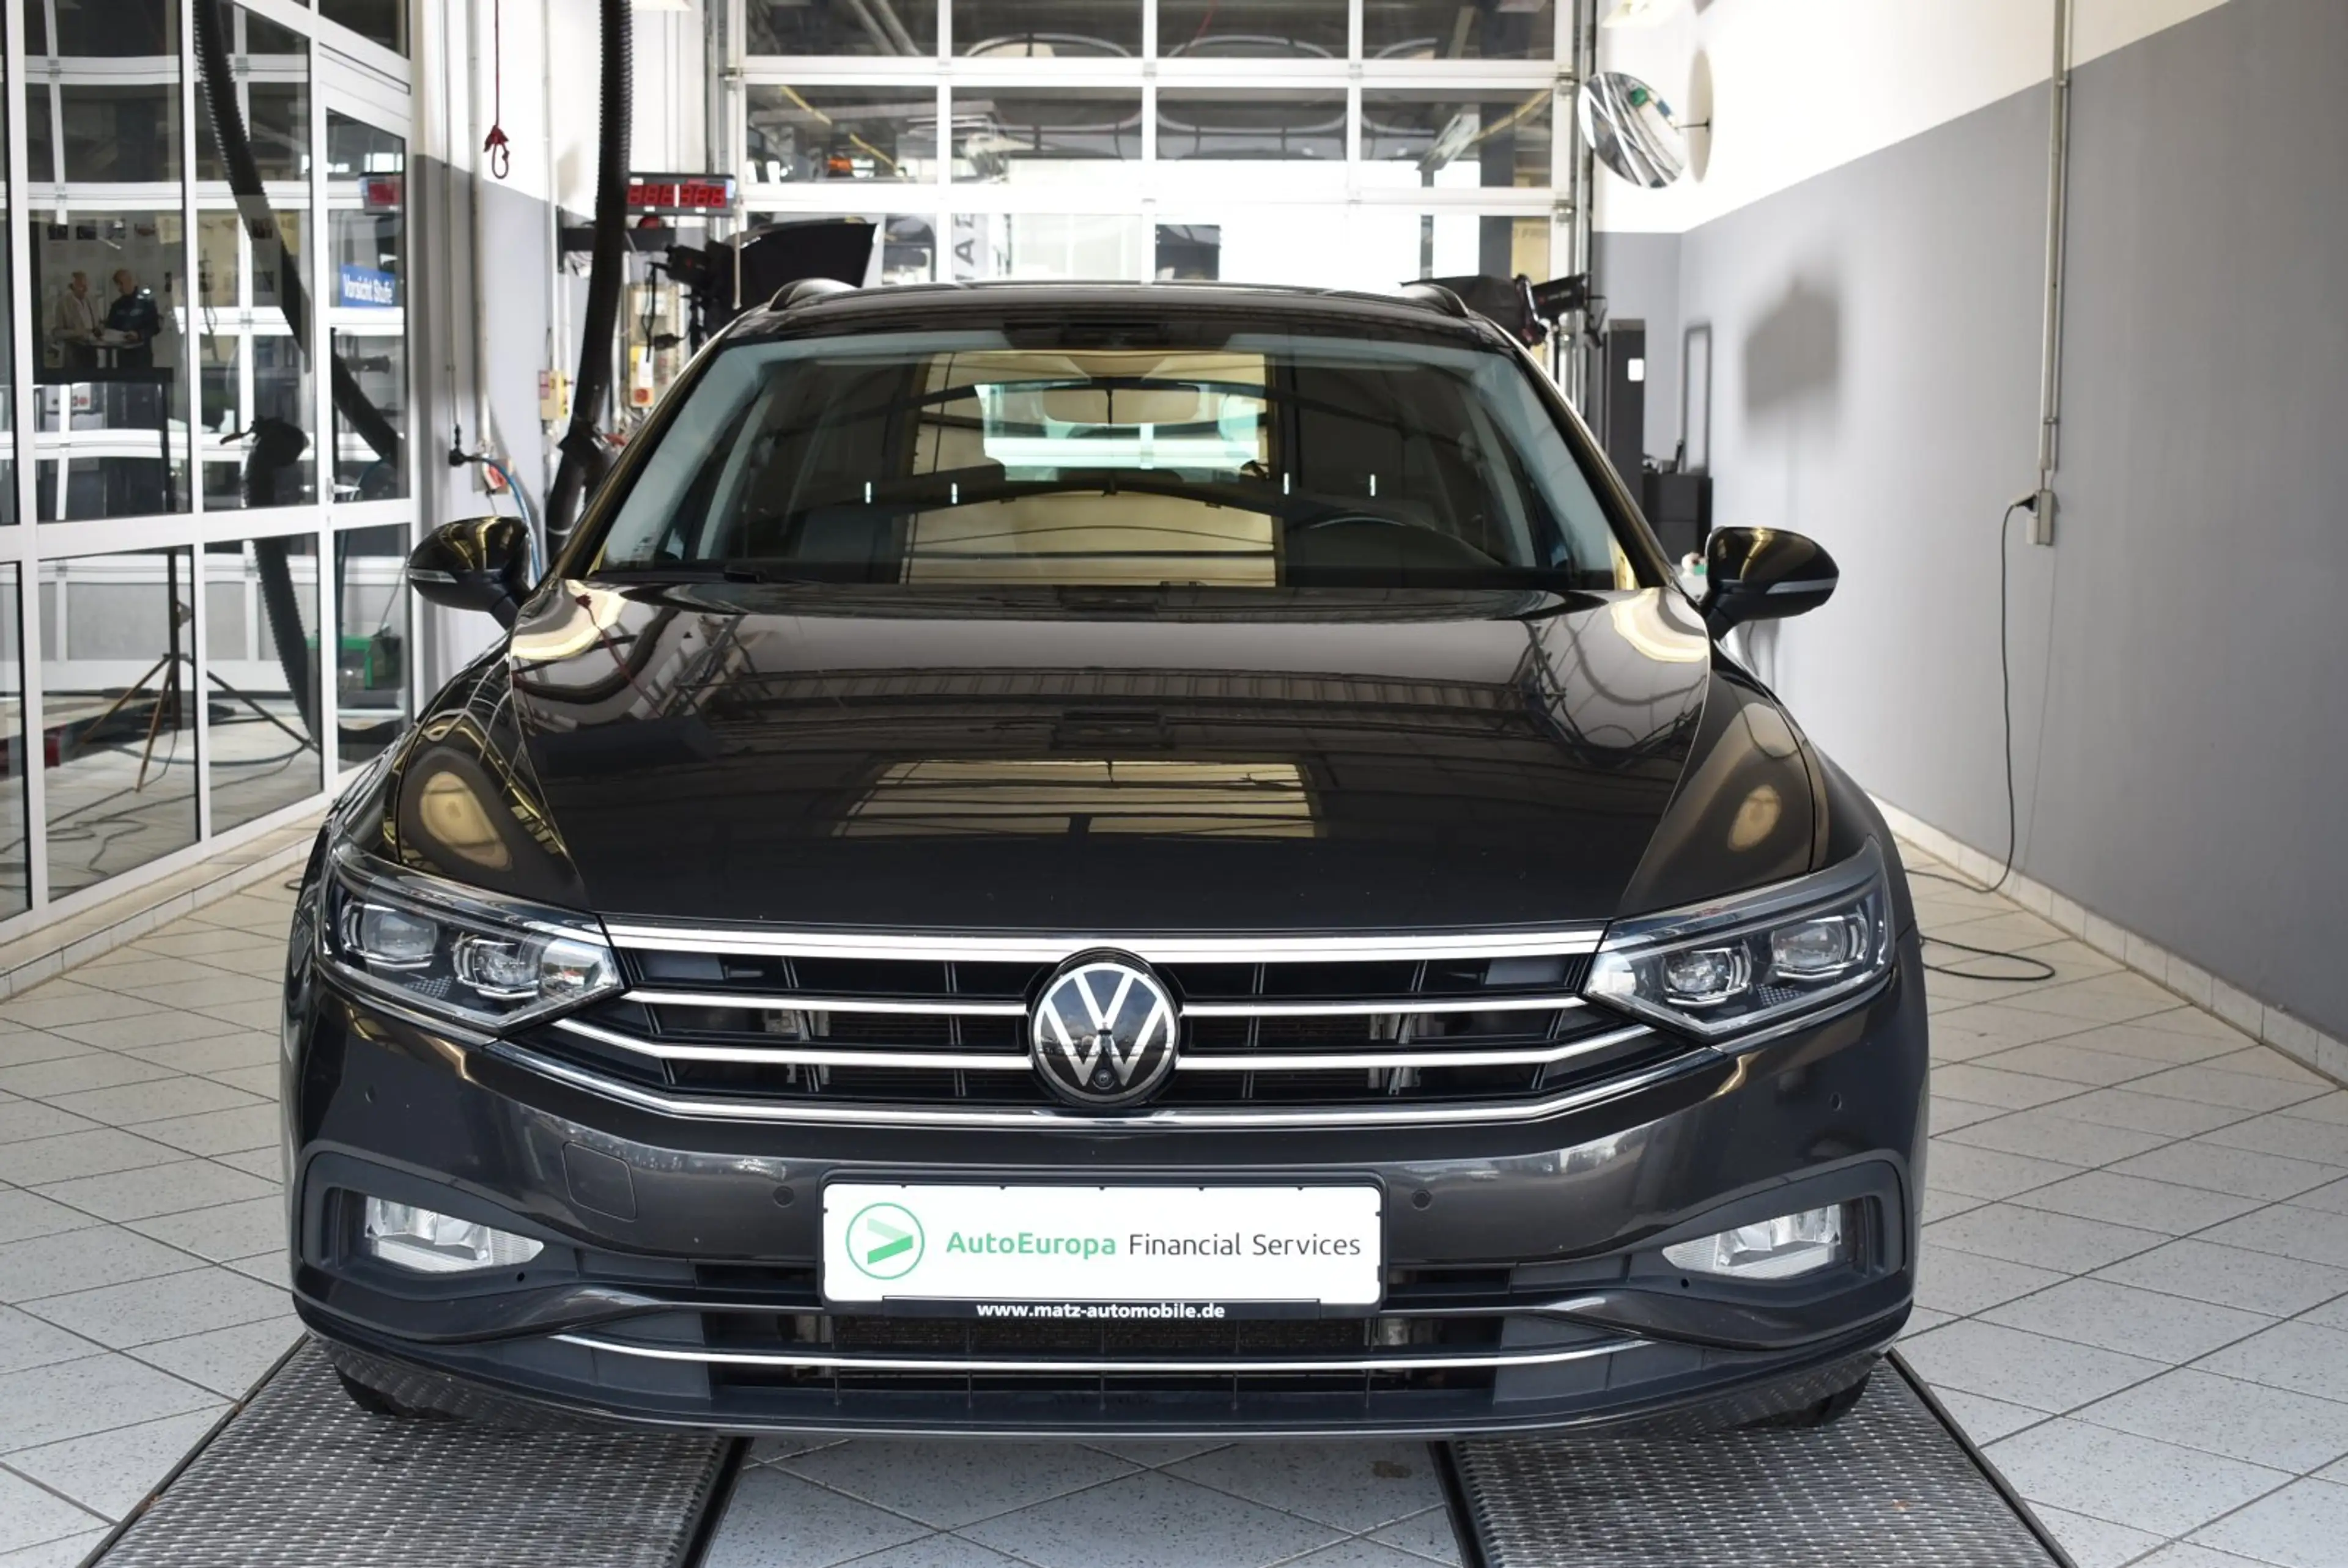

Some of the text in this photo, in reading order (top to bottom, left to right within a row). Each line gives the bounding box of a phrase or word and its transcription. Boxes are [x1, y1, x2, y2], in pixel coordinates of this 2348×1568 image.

[946, 1231, 1362, 1260] AutoEuropa Financial Services
[976, 1303, 1226, 1319] www.matz-automobile.de
